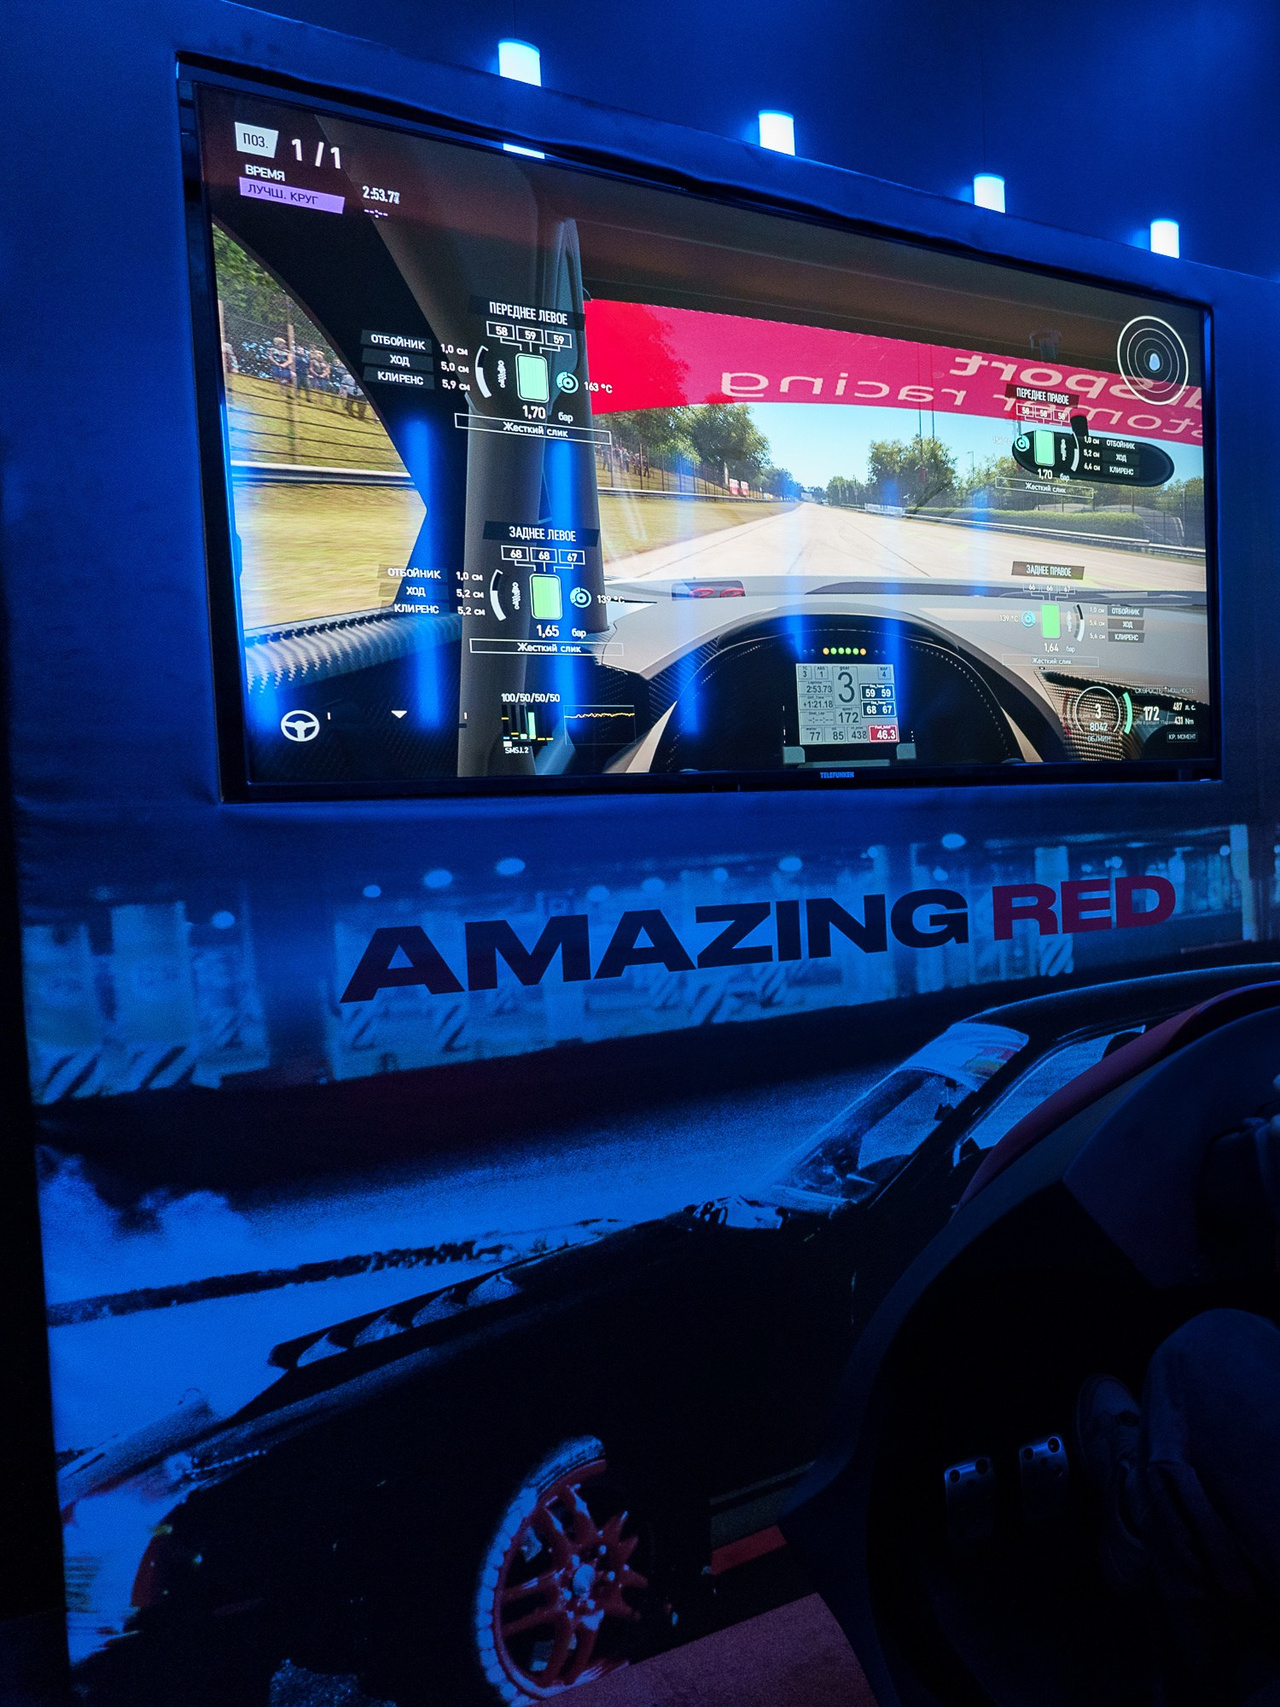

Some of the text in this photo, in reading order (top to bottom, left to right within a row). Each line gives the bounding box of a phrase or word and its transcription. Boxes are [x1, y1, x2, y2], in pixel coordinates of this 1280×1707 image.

[242, 132, 269, 149] ПОЗ.
[244, 164, 286, 182] ВРЕМЯ
[248, 184, 318, 205] ЛУЧШ. КРУГ
[489, 301, 568, 326] ПЕРЕДНЕЕ ЛЕВОЕ
[495, 325, 564, 345] 58 59 59
[370, 334, 468, 356] ОТБОЙНИК 1,0 см
[390, 354, 470, 374] ХОД 5,0 см
[378, 371, 470, 391] КЛИРЕНС 5,9 см
[584, 381, 599, 392] 163
[1016, 386, 1070, 405] ПЕРЕДНЕЕ ПРАВОЕ
[522, 404, 574, 424] 1,70 бар
[503, 421, 568, 438] Жесткий слик
[1084, 436, 1092, 444] 1,0
[1106, 440, 1136, 450] ОТБОЙНИК
[1116, 454, 1127, 462] ХОД
[1038, 468, 1053, 480] 1,70
[1109, 466, 1134, 476] КЛИРЕНС
[1025, 482, 1051, 492] Жесткий
[509, 526, 576, 542] ЗАДНЕЕ ЛЕВОЕ
[510, 549, 578, 562] 68 68 67
[388, 568, 441, 579] ОТБОЙНИК
[456, 571, 469, 581] 1,0
[1026, 564, 1072, 577] ЗАДНЕЕ ПРАВОЕ
[406, 586, 426, 598] ХОД
[456, 589, 470, 598] 5,2
[597, 594, 611, 604] 139
[394, 604, 440, 614] КЛИРЕНС
[457, 607, 472, 616] 5,2
[1111, 608, 1140, 616] ОТБОЙНИК
[536, 625, 586, 638] 1,65 бар
[517, 642, 581, 653] Жесткий слик
[1044, 643, 1059, 653] 1,64
[1032, 657, 1058, 665] Жесткий
[802, 670, 807, 678] 3
[806, 685, 832, 693] 2:53.73
[838, 671, 855, 703] 3
[866, 688, 891, 698] 59 59
[501, 692, 561, 703] 100/50/50/50
[804, 700, 834, 708] +1:21.18
[866, 706, 892, 714] 68 67
[1095, 703, 1102, 719] 3
[1143, 706, 1160, 721] 172
[838, 712, 859, 723] 172
[1090, 722, 1108, 731] 8042
[810, 732, 821, 741] 77
[833, 732, 844, 740] 85
[851, 730, 868, 739] 438
[876, 730, 896, 740] 46.3
[820, 771, 855, 779] TELEFUNKEN
[339, 873, 1178, 1003] AMAZING RED
